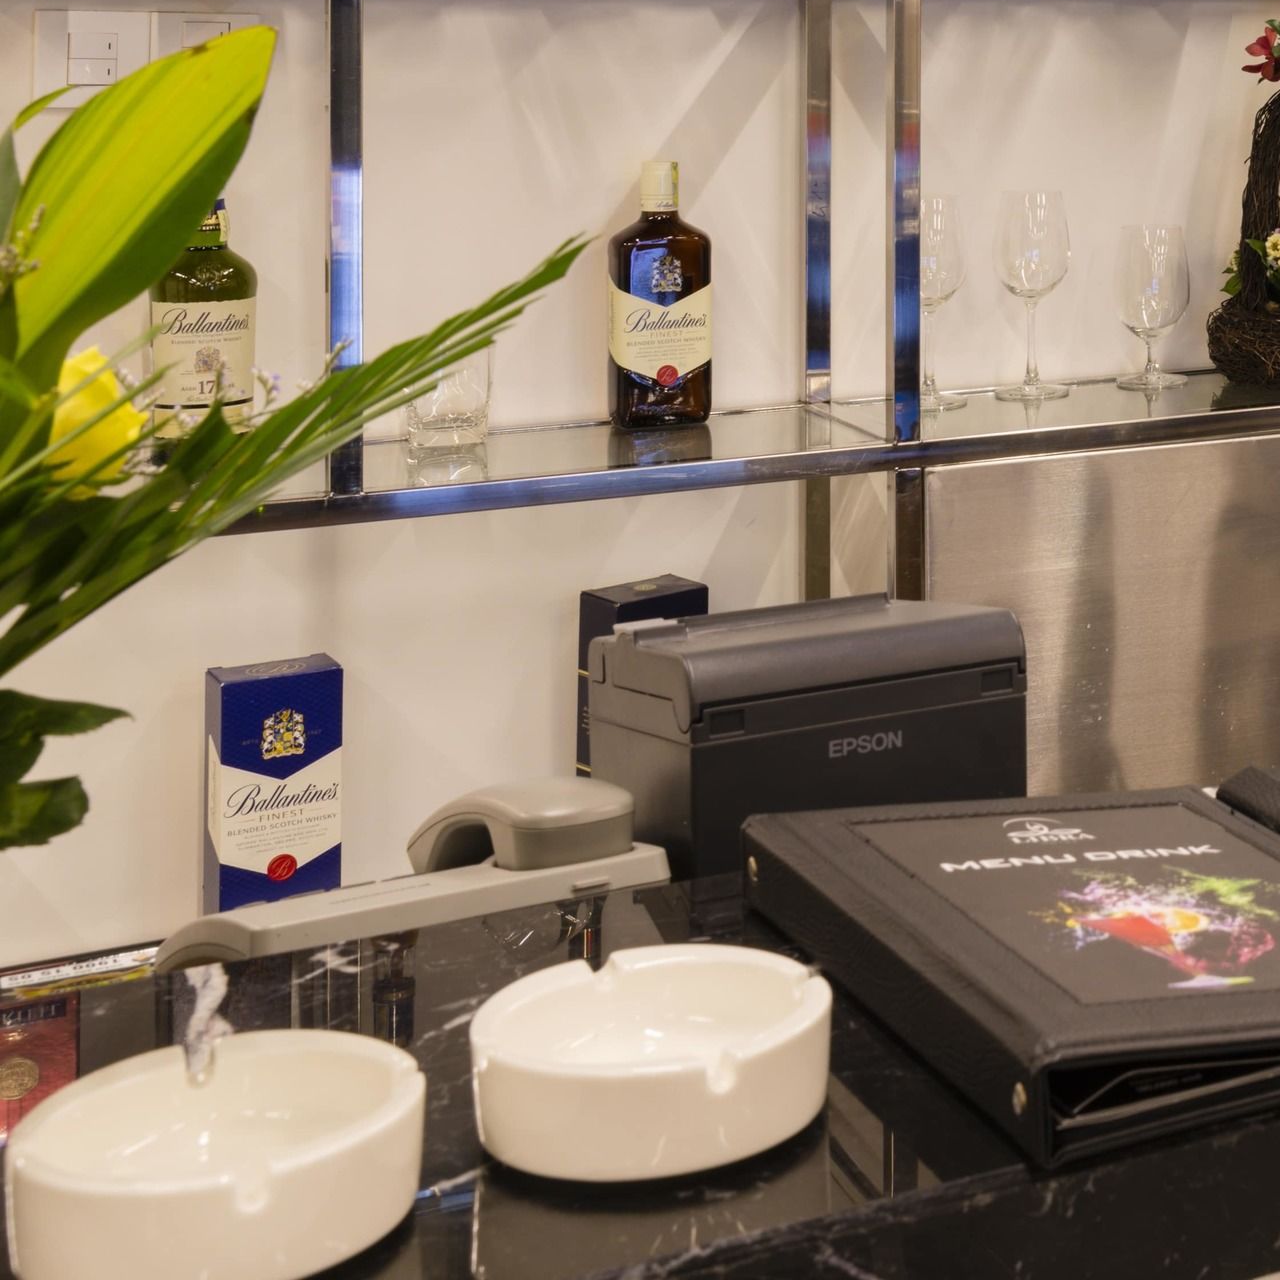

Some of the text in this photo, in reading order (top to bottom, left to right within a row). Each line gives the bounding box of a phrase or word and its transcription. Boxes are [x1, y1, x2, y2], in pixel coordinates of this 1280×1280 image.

[160, 307, 250, 335] Ballantine's
[624, 308, 708, 333] Ballantine's
[650, 330, 684, 338] FINEST
[198, 380, 216, 395] 17
[829, 730, 902, 758] EPSON
[224, 782, 341, 819] Ballantine's
[227, 812, 338, 837] BLENDED SCOTCH WHISKY
[259, 808, 304, 823] FINEST
[1011, 832, 1096, 845] LIBRA
[939, 844, 1222, 872] MENU DRINK
